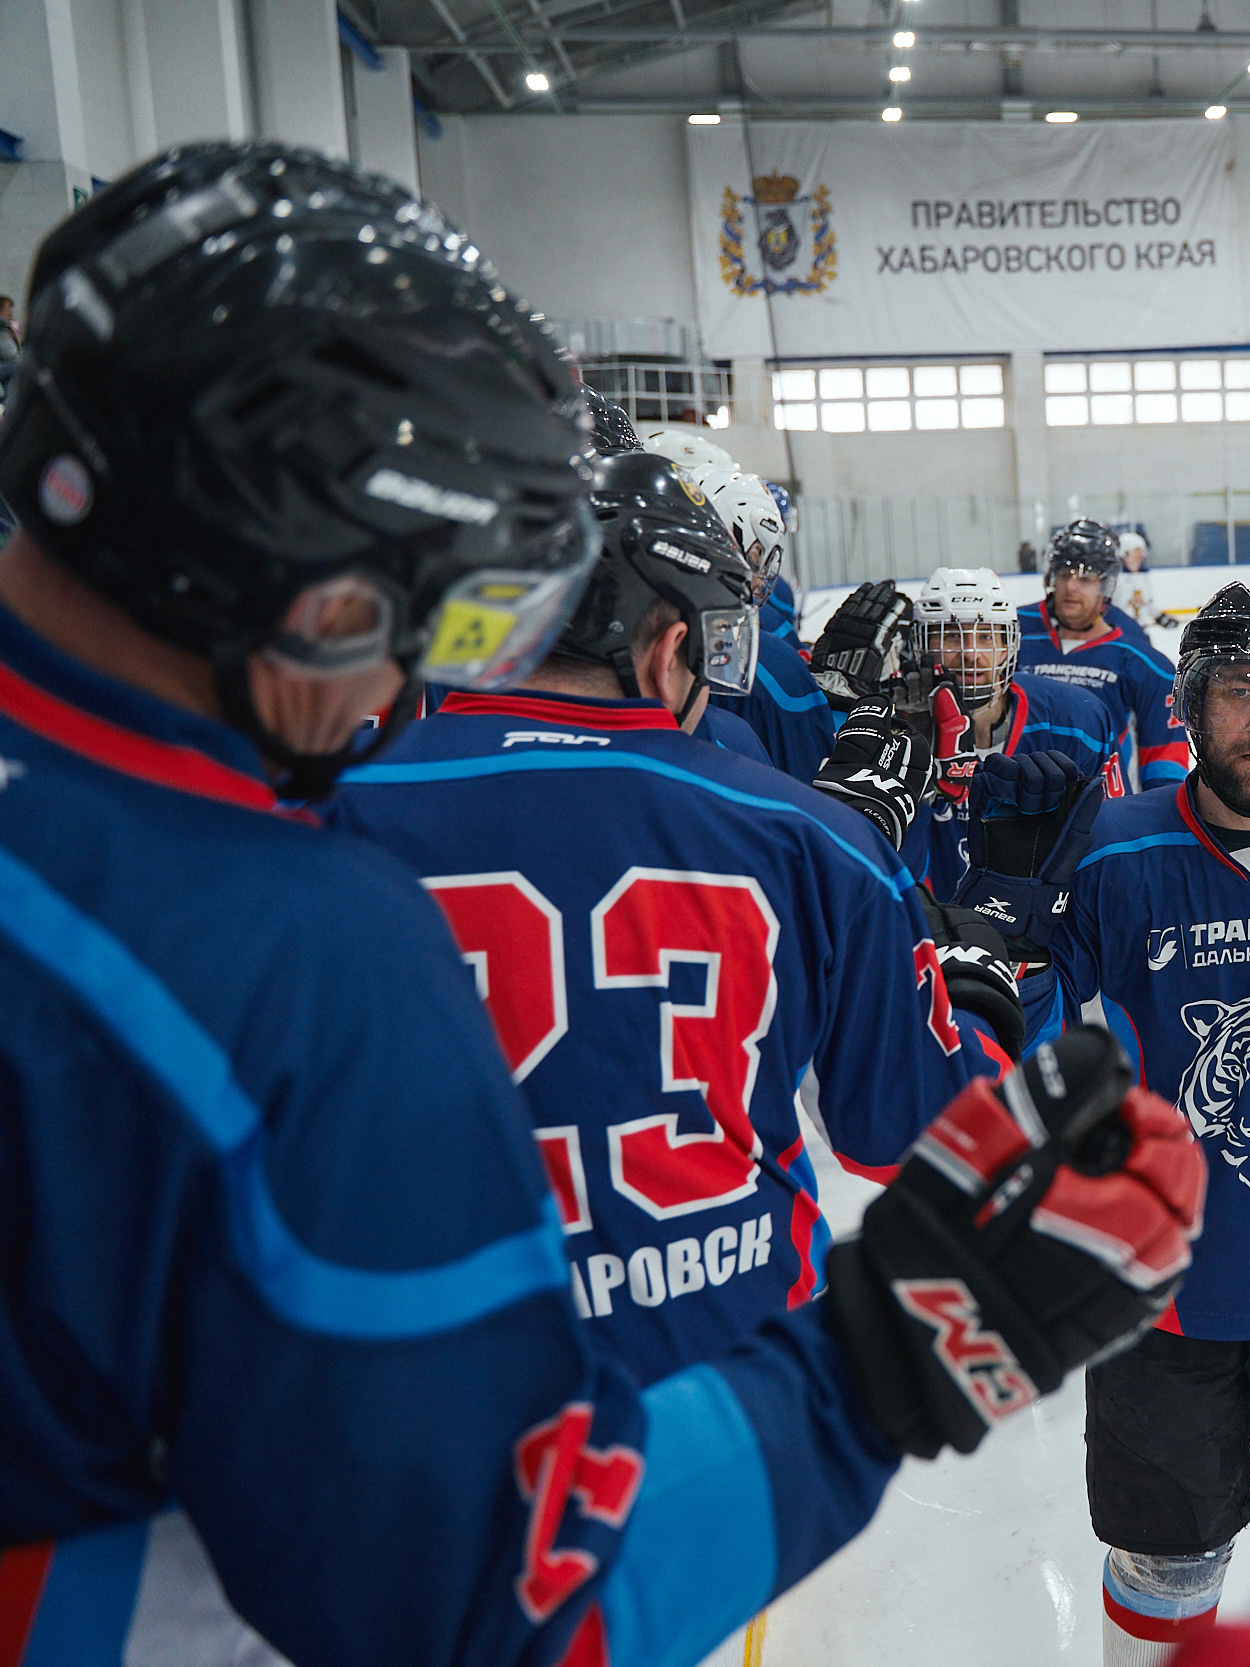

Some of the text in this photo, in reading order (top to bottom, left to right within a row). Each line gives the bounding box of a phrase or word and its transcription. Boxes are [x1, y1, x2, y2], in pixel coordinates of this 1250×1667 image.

[911, 198, 1181, 230] ПРАВИТЕЛЬСТВО
[877, 240, 1216, 275] ХАБАРОВСКОГО КРАЯ
[974, 904, 1017, 923] BAUER
